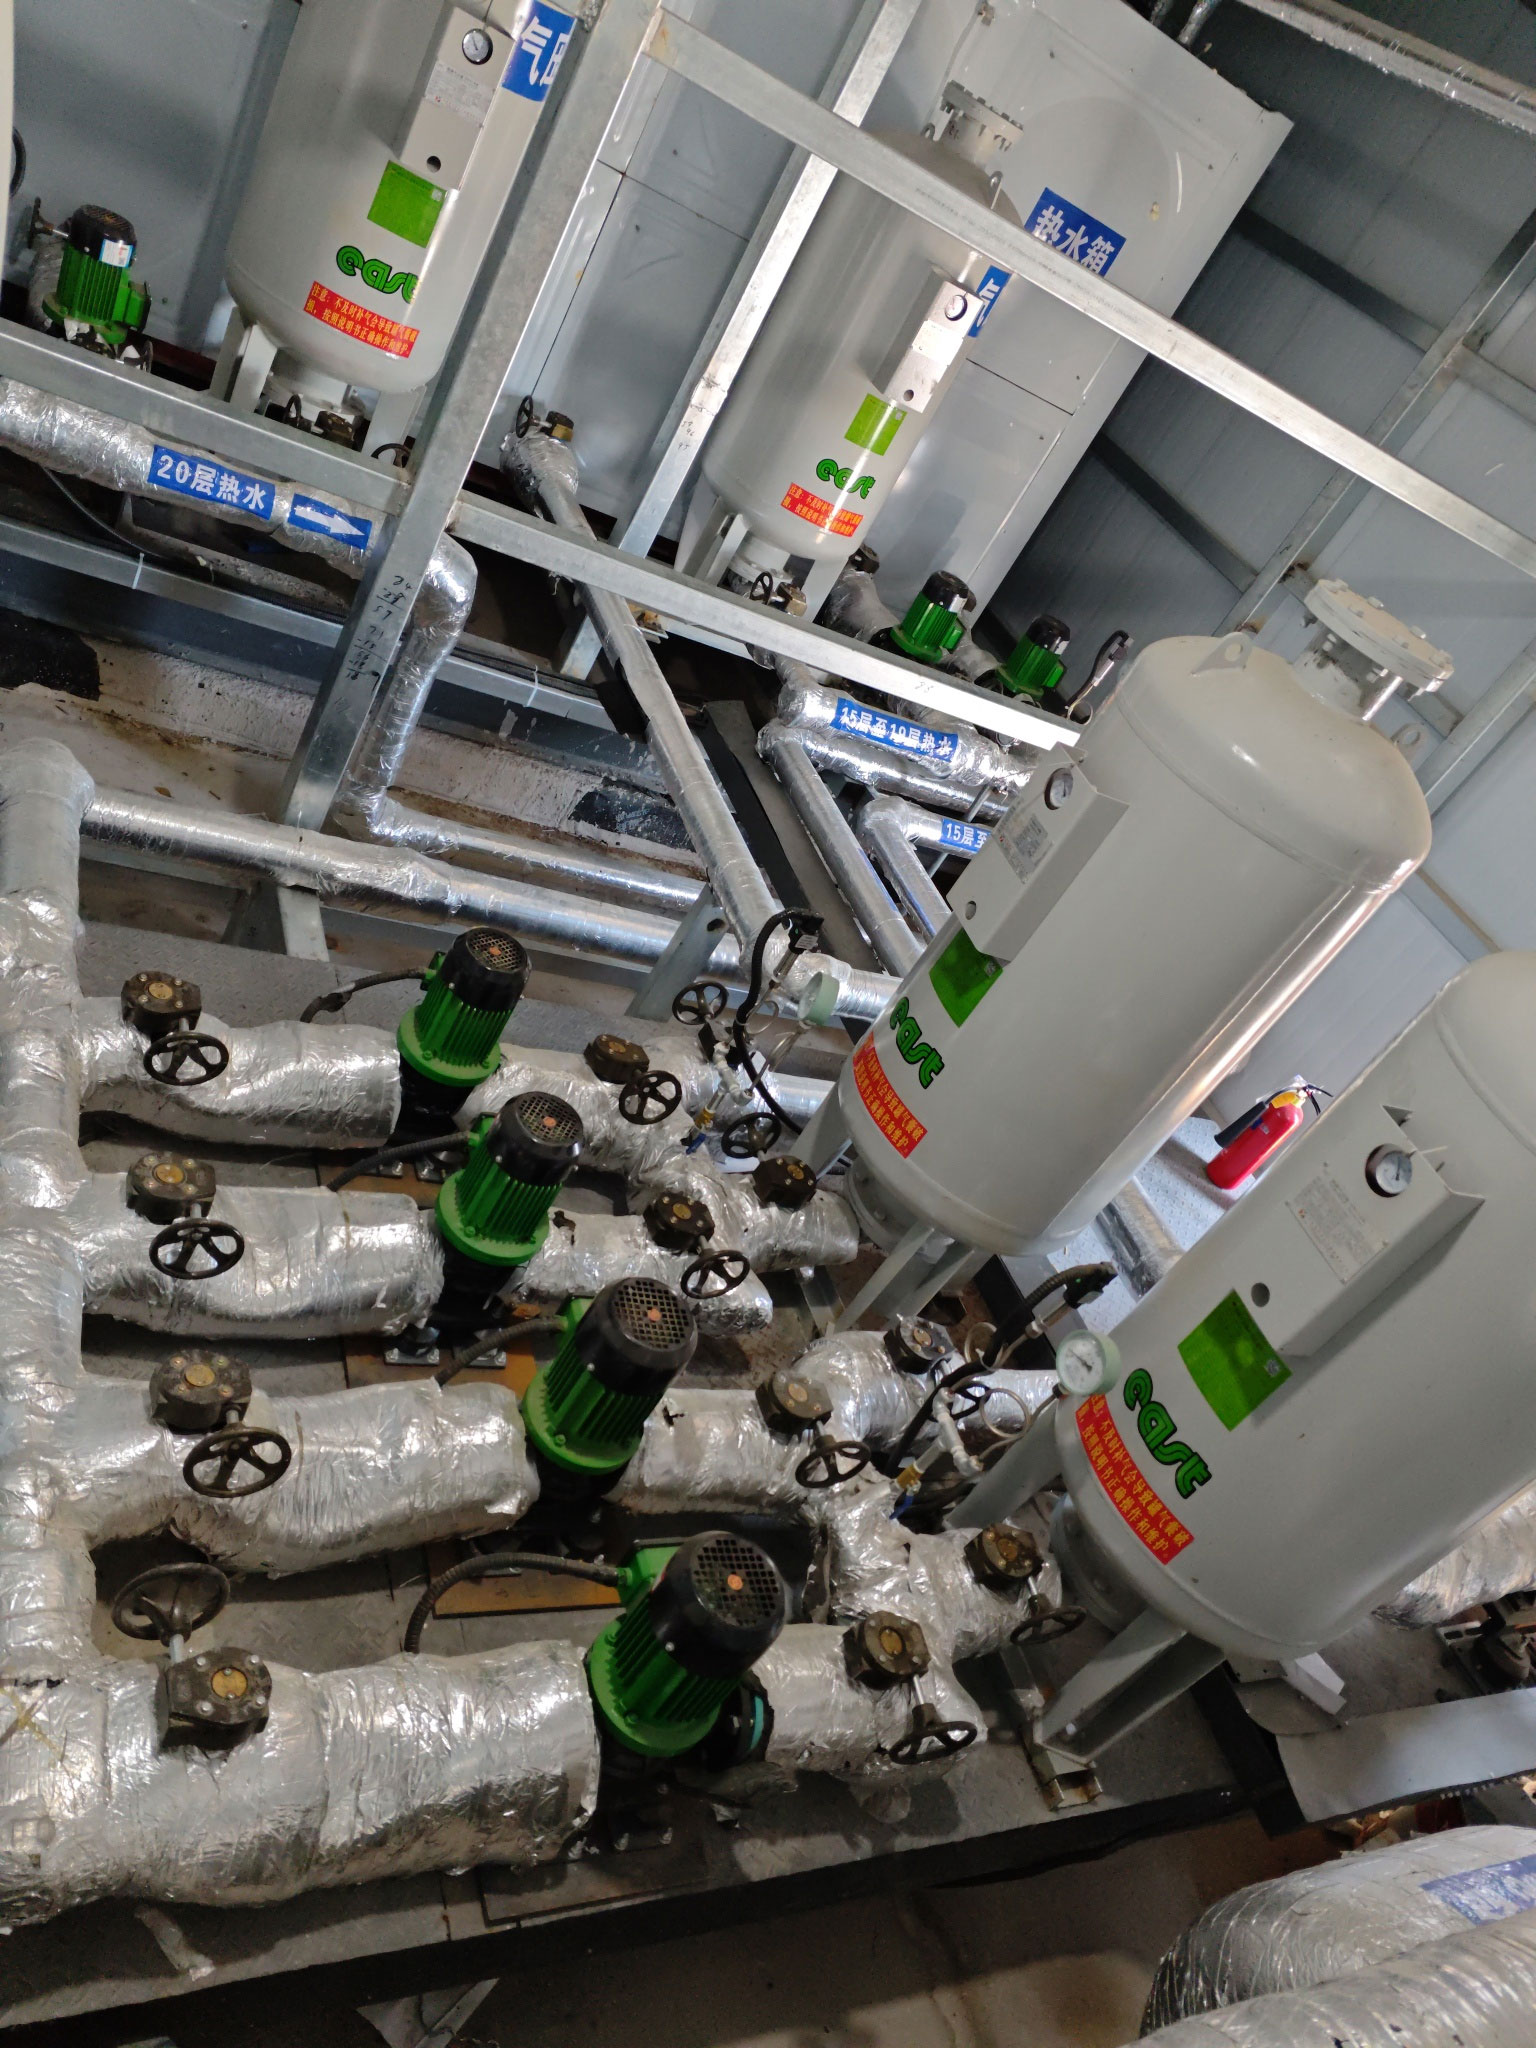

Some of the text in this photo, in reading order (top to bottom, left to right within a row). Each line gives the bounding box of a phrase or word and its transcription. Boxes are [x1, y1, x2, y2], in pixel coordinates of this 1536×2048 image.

[1032, 205, 1115, 274] 热水箱
[156, 455, 266, 510] 20层热水
[946, 823, 988, 849] 15层至
[890, 997, 945, 1089] east
[1123, 1368, 1212, 1499] east
